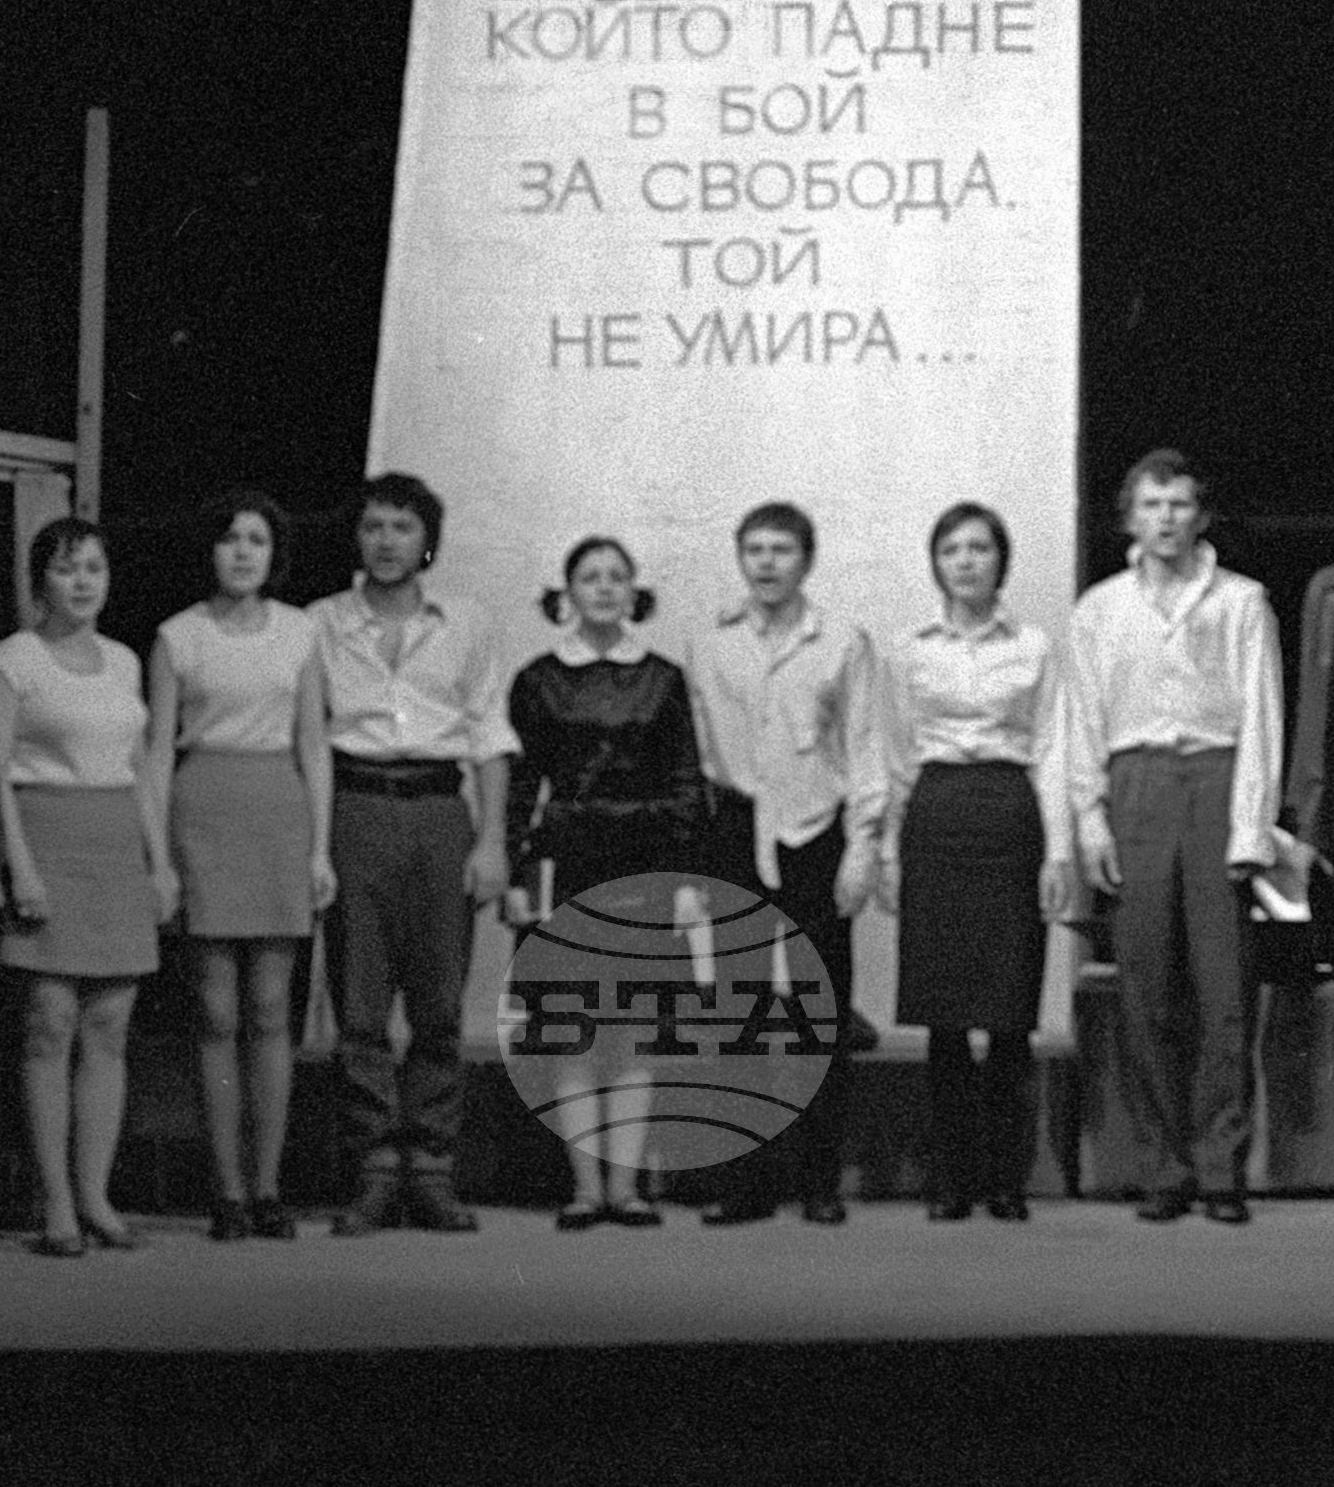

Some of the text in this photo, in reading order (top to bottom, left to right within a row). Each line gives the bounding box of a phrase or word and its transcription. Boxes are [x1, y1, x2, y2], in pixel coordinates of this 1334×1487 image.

[628, 66, 868, 140] В БОЙ
[519, 156, 604, 215] ЗА
[662, 225, 823, 290] ТОЙ
[547, 313, 643, 370] НЕ
